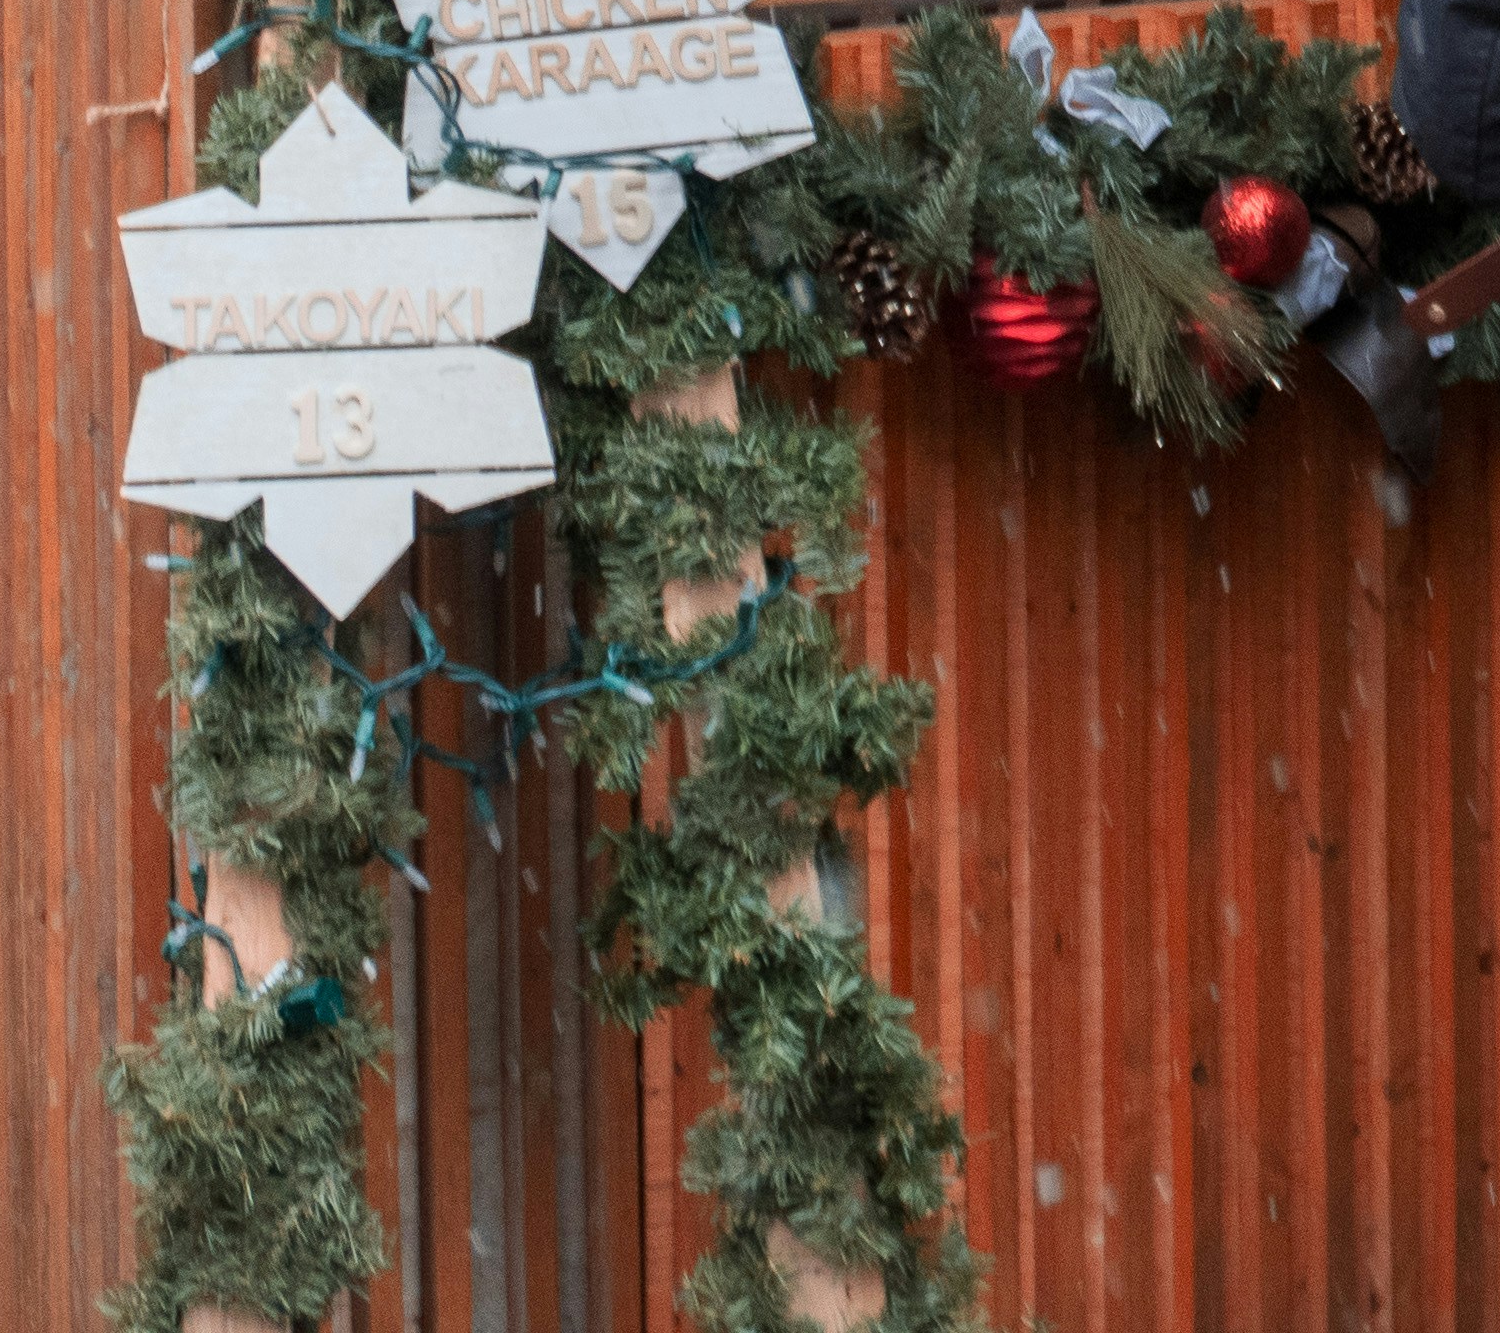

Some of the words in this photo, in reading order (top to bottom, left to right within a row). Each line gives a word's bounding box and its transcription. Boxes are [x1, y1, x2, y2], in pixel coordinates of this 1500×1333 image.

[437, 23, 760, 108] KARAAGE
[569, 168, 655, 248] 15
[170, 285, 485, 353] TAKOYAKI
[291, 385, 374, 465] 13
